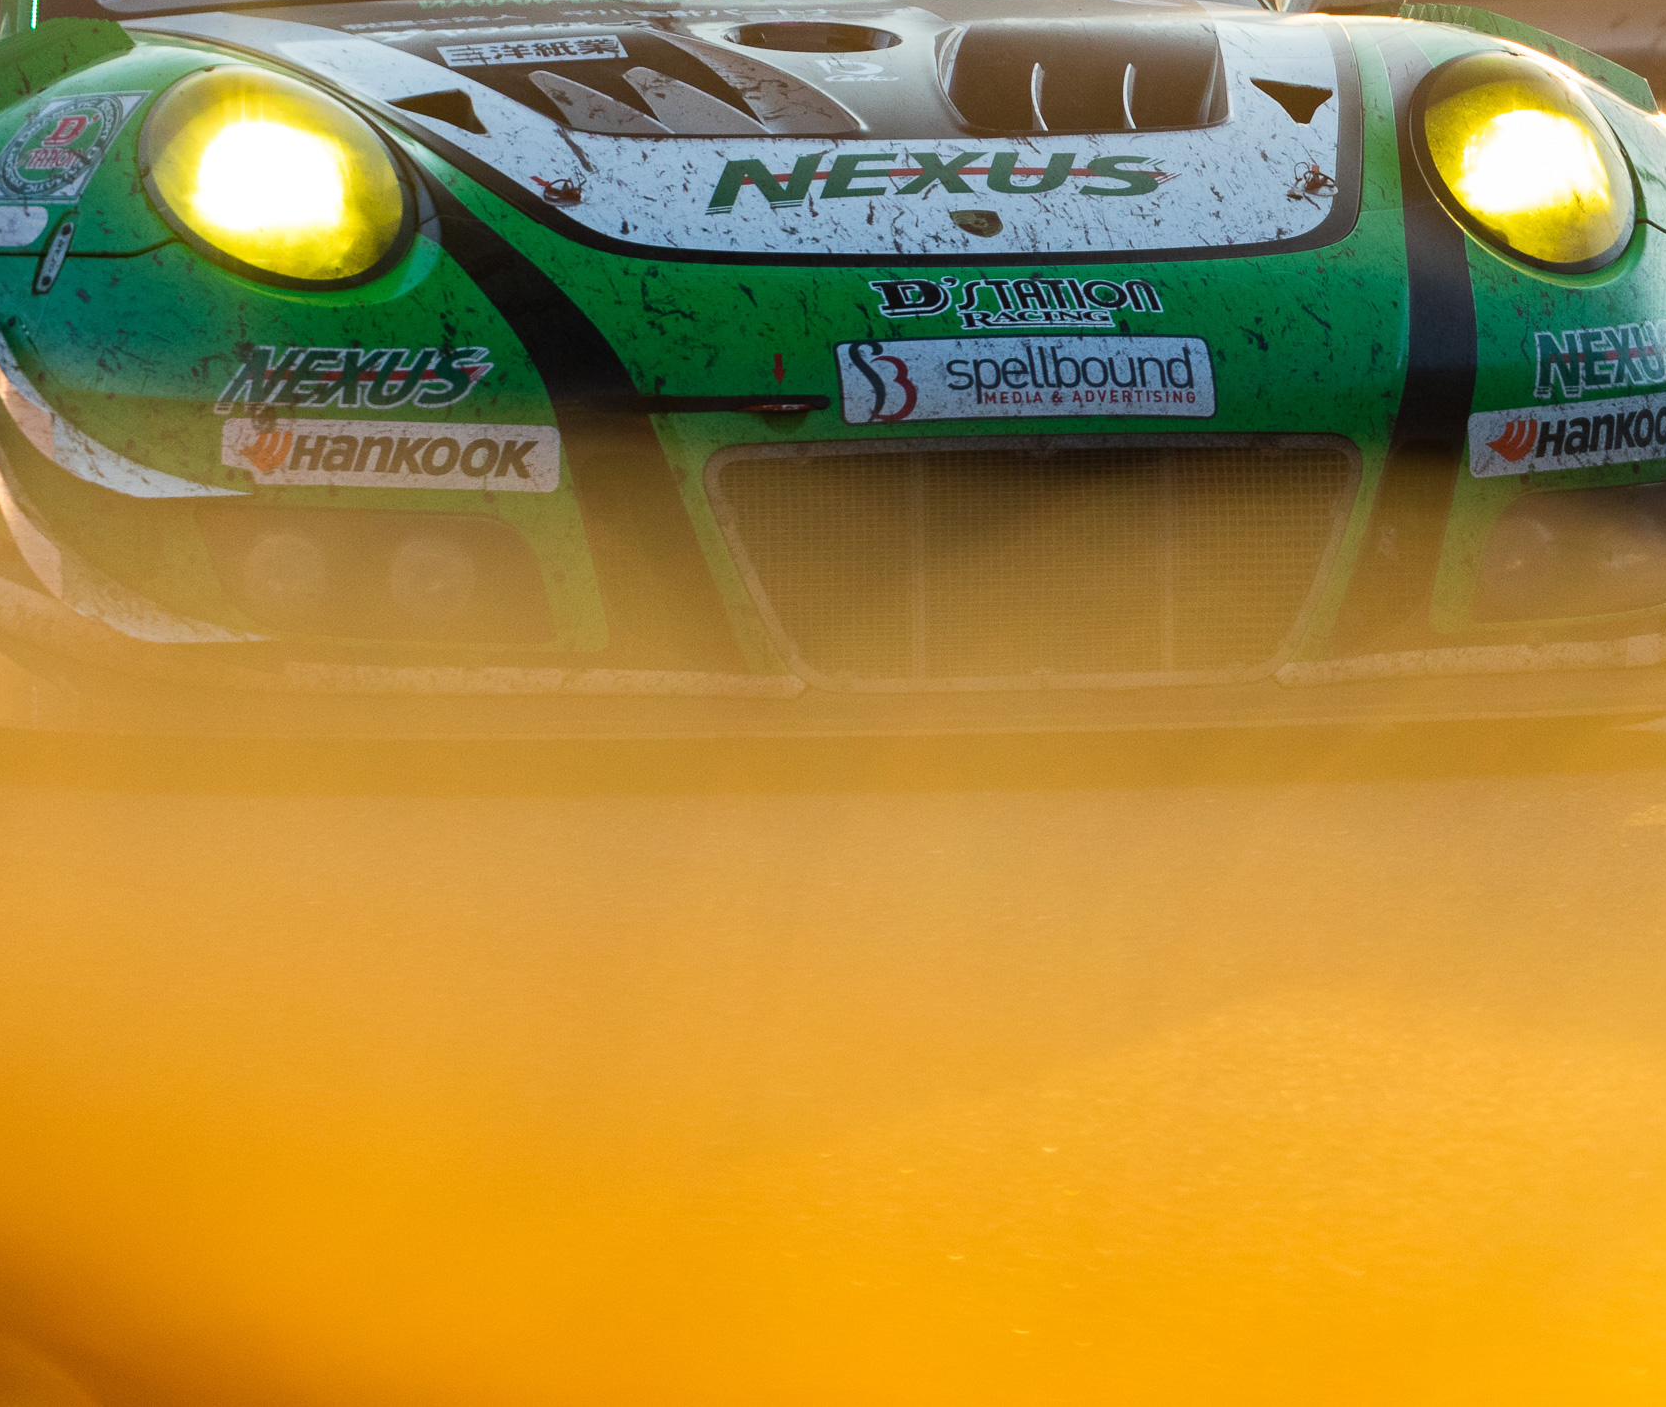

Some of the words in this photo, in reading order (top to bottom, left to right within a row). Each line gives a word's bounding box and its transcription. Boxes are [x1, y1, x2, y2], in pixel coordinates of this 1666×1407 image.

[705, 152, 1171, 214] NEXUS
[870, 277, 1163, 318] D'STATION
[961, 309, 1115, 330] RACING
[213, 346, 495, 415] NEXUS
[946, 345, 1195, 405] spellbound
[984, 392, 1043, 405] MEDIA
[1052, 391, 1064, 403] &
[1072, 390, 1197, 404] ADVERTISING
